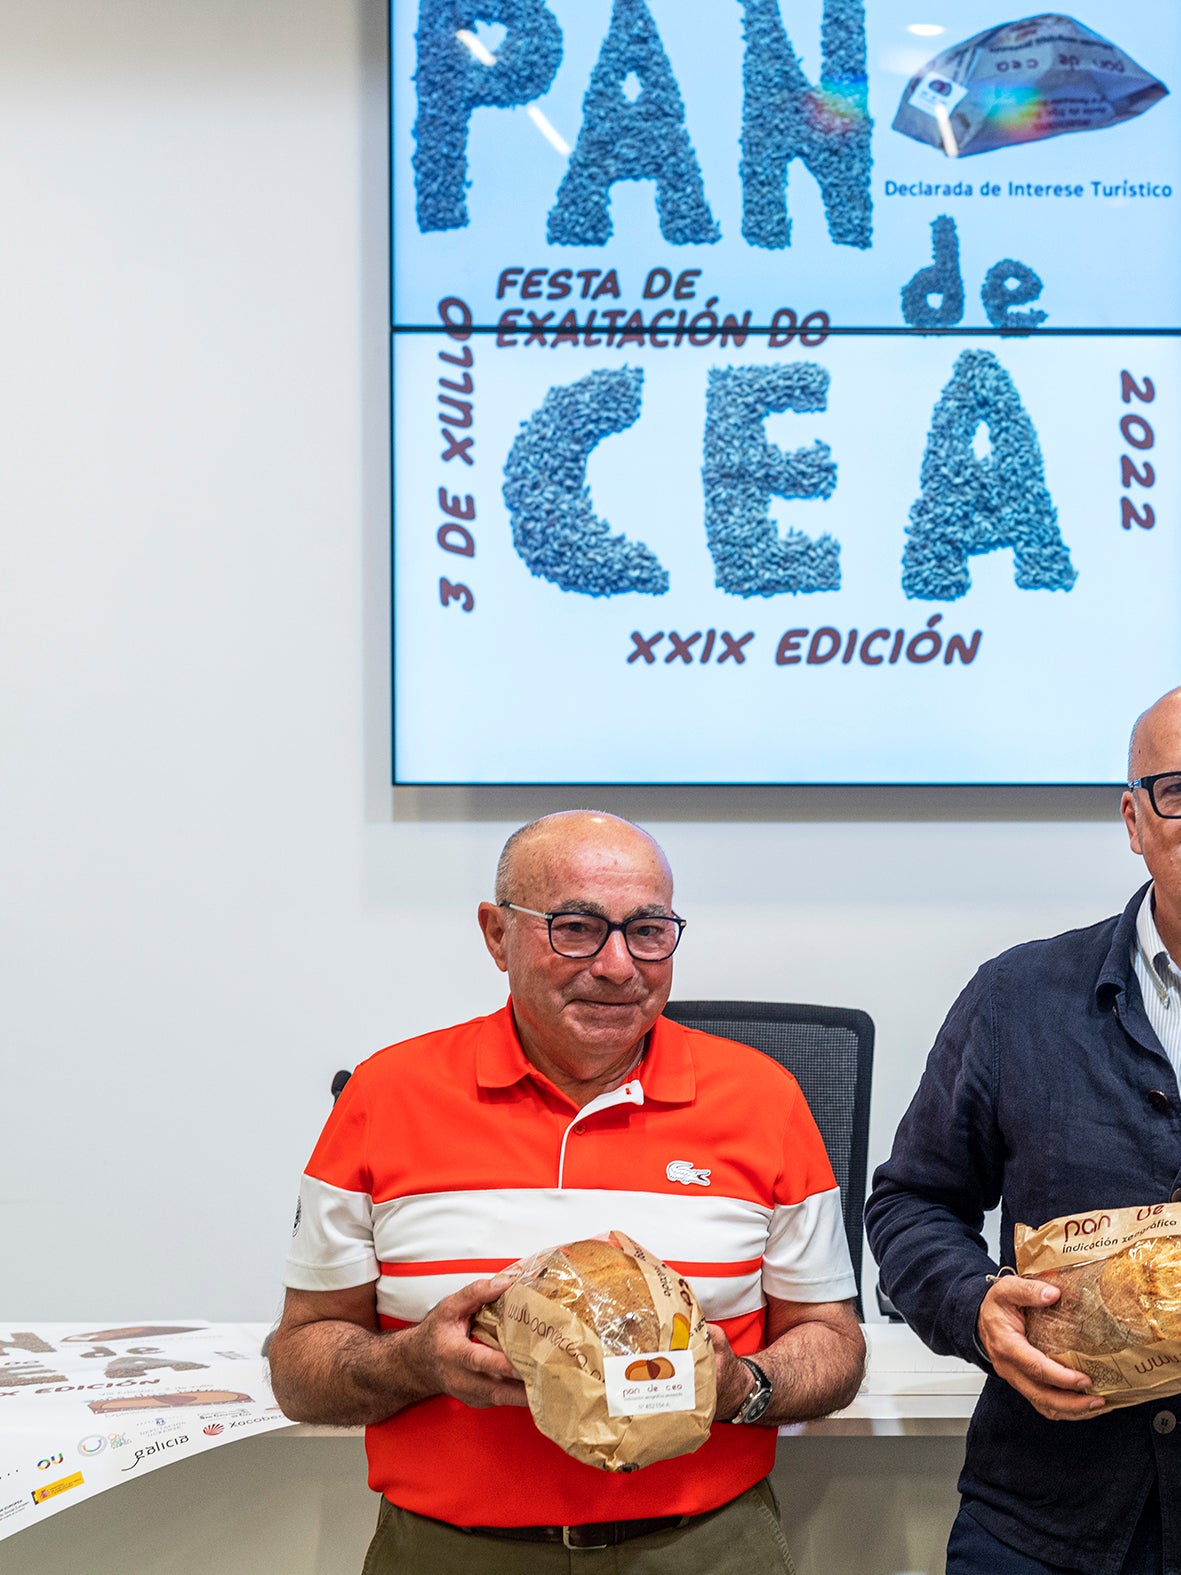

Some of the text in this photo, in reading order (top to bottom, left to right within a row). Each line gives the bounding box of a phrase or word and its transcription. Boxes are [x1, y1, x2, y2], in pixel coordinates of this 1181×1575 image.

[411, 0, 876, 249] PAN
[884, 179, 1173, 198] Declarada de Interese Turístico
[496, 268, 702, 301] FESTA DE
[900, 213, 1050, 336] de
[494, 296, 831, 349] EXALTACIÓN DO
[437, 296, 477, 613] 3 DE XULLO
[1119, 368, 1157, 532] 2022
[502, 348, 1079, 600] CEA
[626, 614, 983, 667] XXIX EDICIÓN
[1062, 1237, 1119, 1255] indicación
[1063, 1214, 1112, 1243] pan
[34, 1378, 161, 1394] EDICIÓN
[622, 1387, 641, 1399] pan
[647, 1383, 659, 1393] de
[665, 1383, 683, 1392] cea
[121, 1434, 190, 1472] galicia
